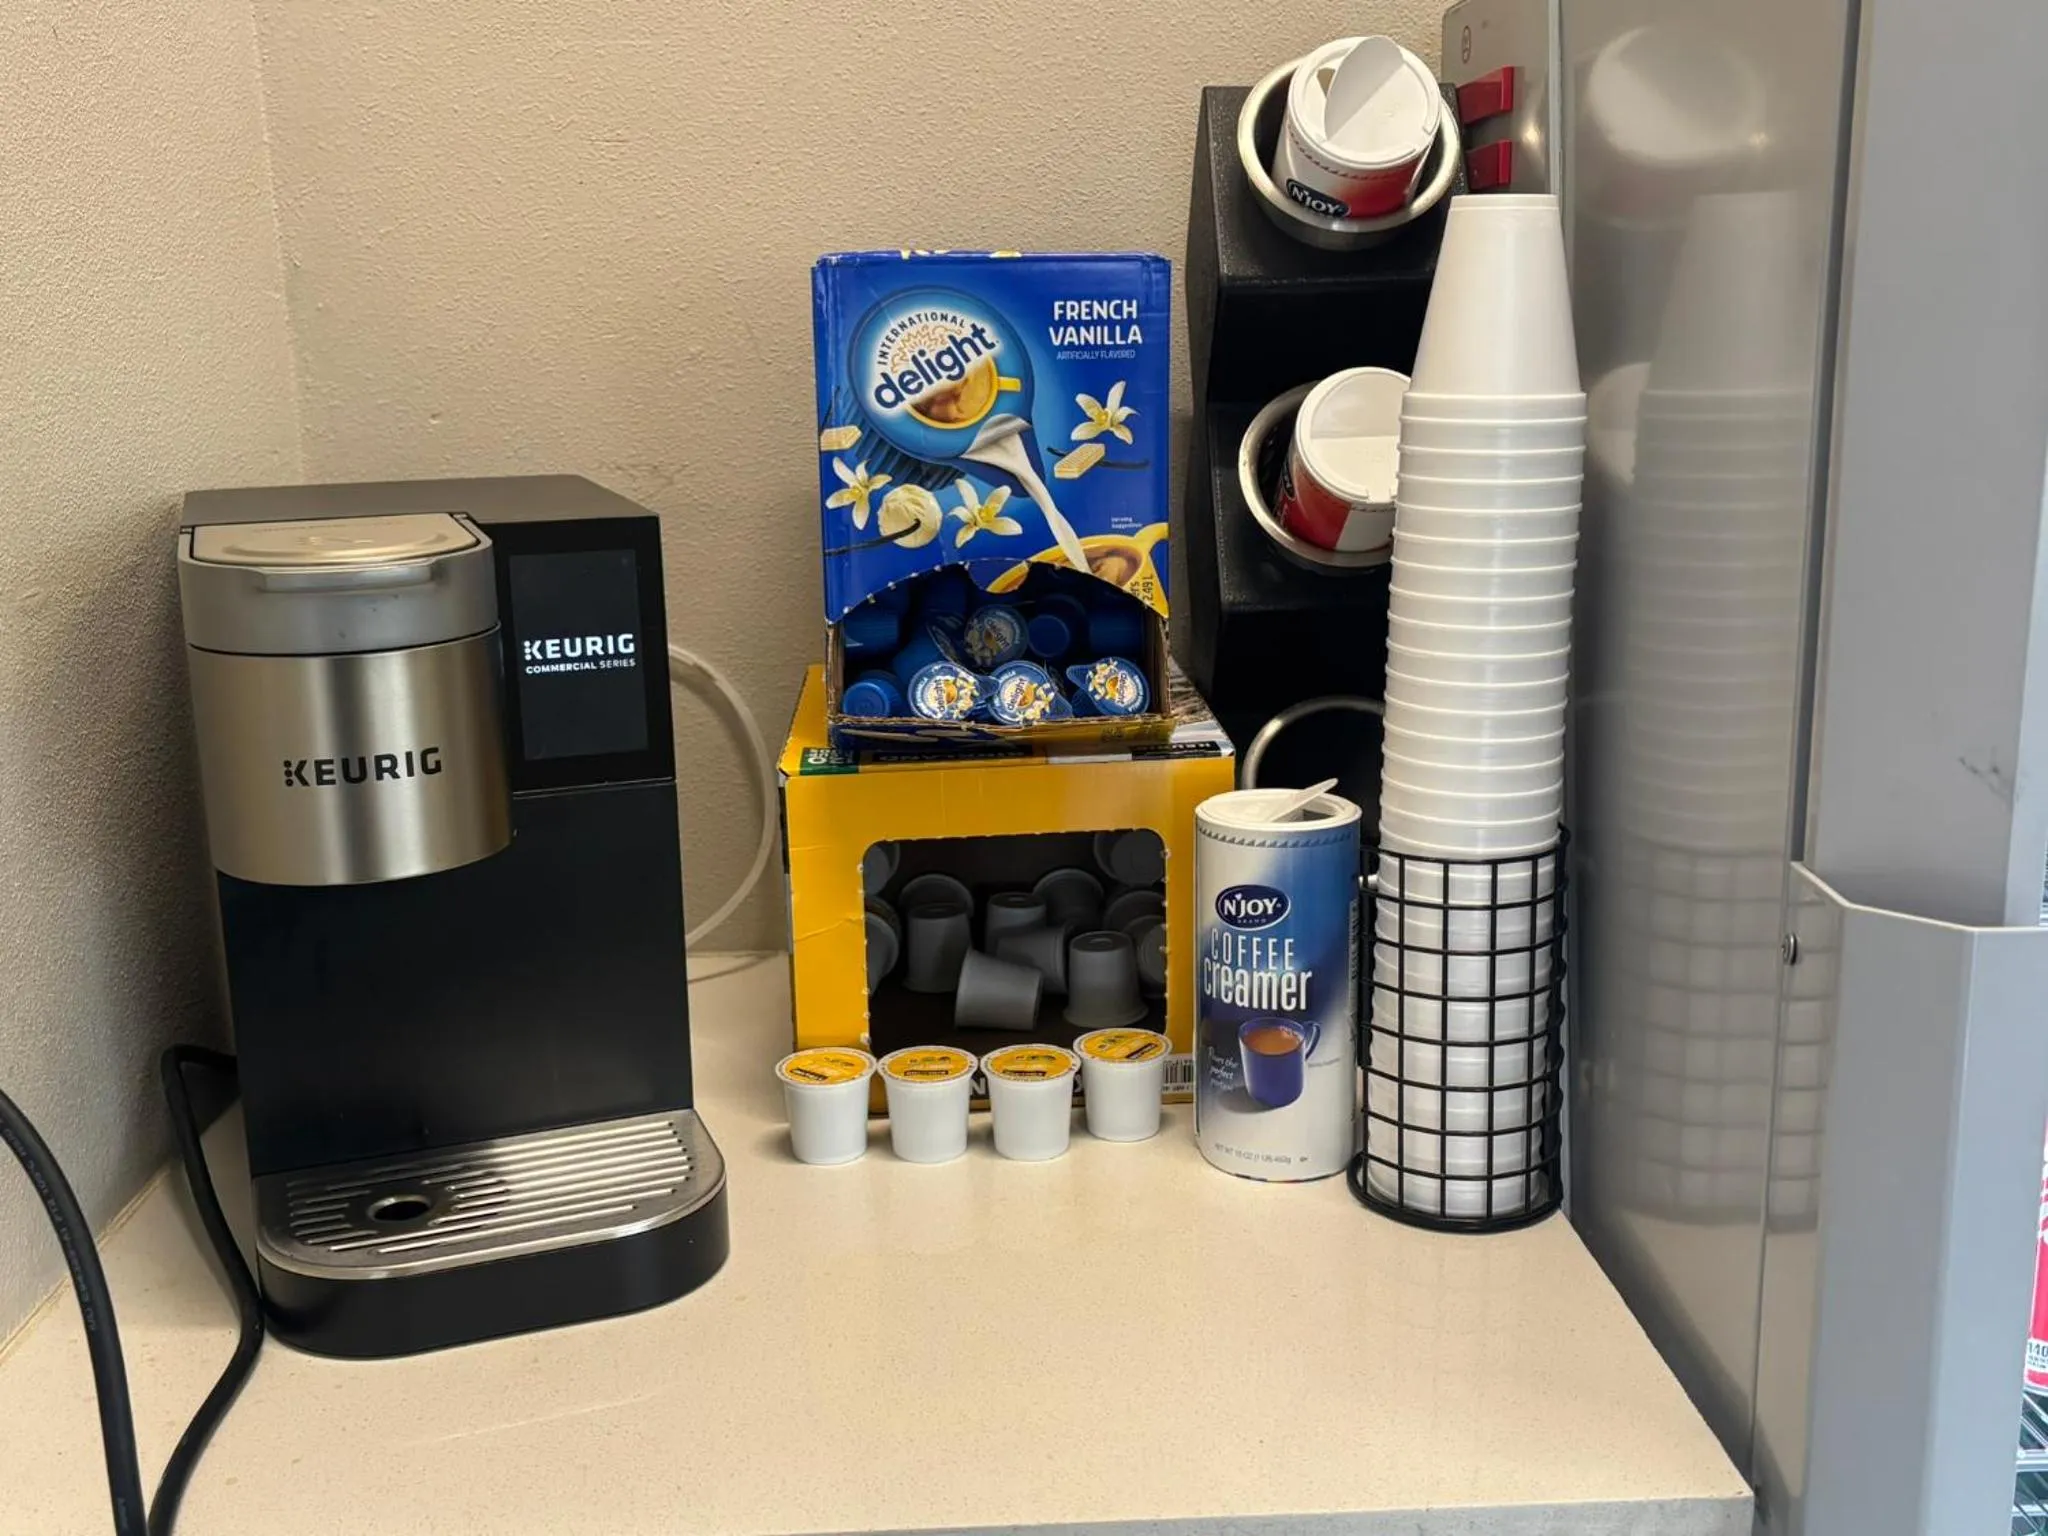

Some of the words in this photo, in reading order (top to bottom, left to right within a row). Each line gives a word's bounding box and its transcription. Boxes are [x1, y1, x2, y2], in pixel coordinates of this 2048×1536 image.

[1053, 299, 1138, 321] FRENCH
[877, 311, 965, 366] INTERNATIONAL
[1048, 324, 1143, 346] VANILLA
[874, 323, 996, 409] delight
[523, 633, 635, 661] KEURIG
[525, 661, 598, 674] COMMERCIAL
[599, 658, 636, 669] SERIES
[283, 746, 442, 788] KEURIG
[1211, 928, 1295, 971] COFFEE
[1204, 958, 1313, 1011] creamer
